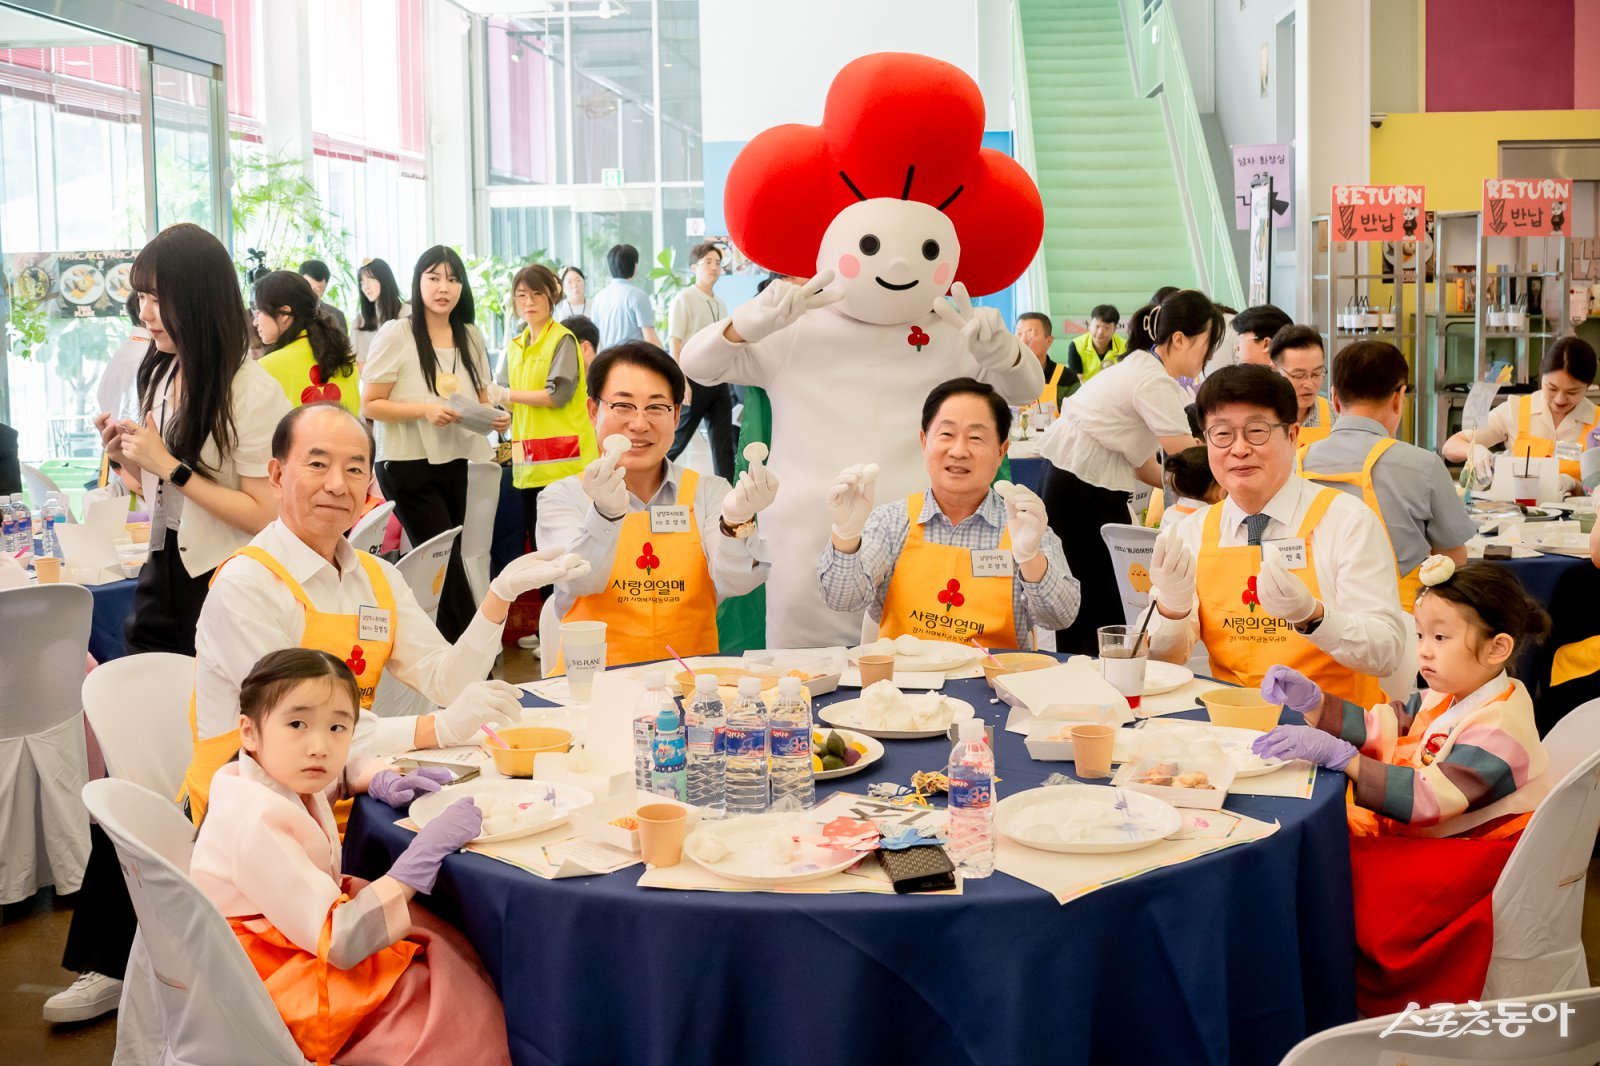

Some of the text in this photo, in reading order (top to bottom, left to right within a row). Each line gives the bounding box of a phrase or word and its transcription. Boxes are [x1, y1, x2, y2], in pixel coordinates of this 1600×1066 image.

[1334, 186, 1422, 206] RETURN
[1486, 179, 1569, 200] RETURN
[1361, 213, 1396, 233] 반납
[1511, 207, 1544, 227] 반납
[612, 579, 685, 596] 사랑의열매
[909, 609, 985, 635] 사랑의열매
[1222, 617, 1293, 635] 사랑의열매
